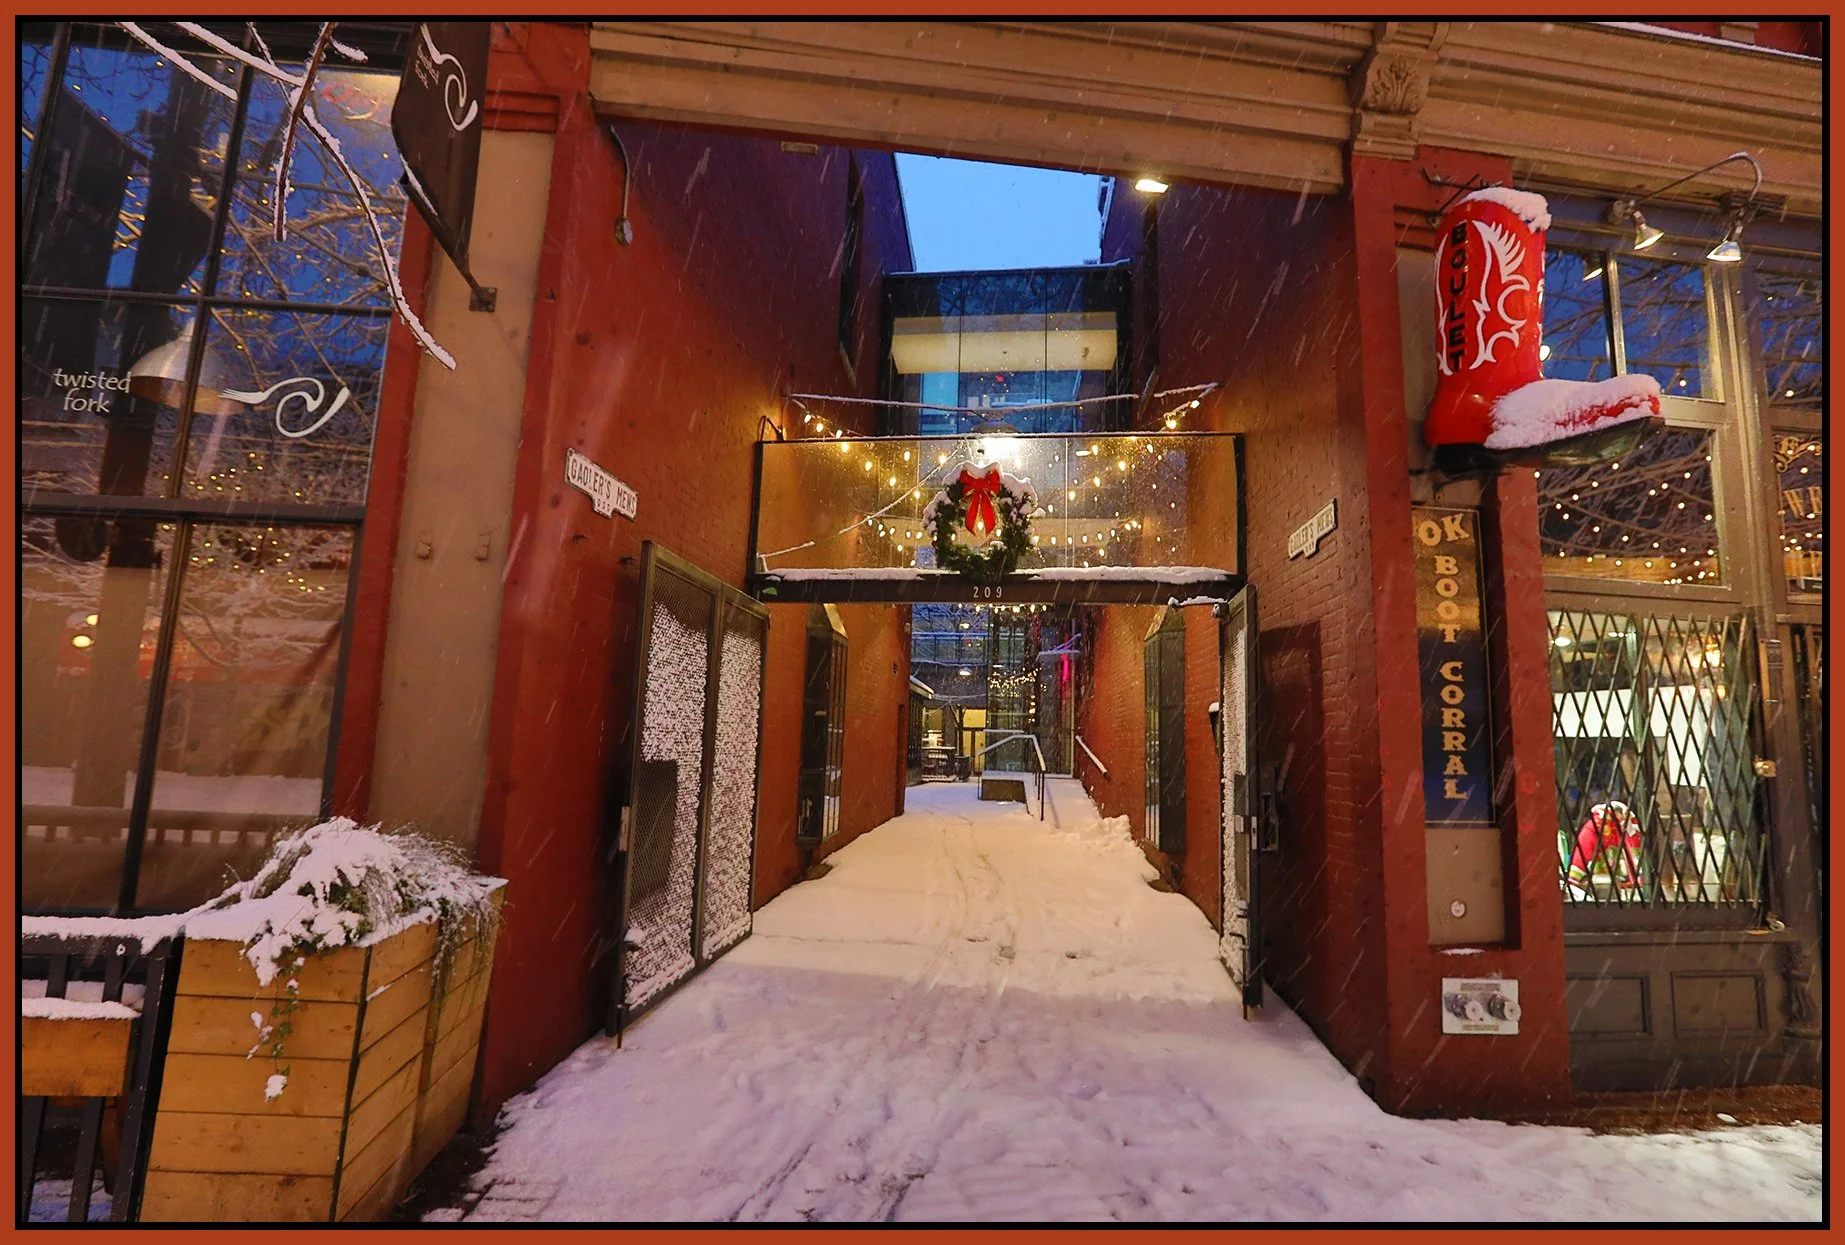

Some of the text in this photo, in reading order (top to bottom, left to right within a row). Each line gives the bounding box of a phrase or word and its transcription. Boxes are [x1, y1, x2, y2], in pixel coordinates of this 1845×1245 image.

[1448, 220, 1468, 373] BOULET
[53, 368, 132, 393] twisted
[63, 388, 110, 413] fork
[615, 486, 636, 515] MEWS
[1420, 513, 1470, 547] OK
[973, 586, 1002, 599] 209
[1434, 555, 1461, 643] BOOT
[1440, 661, 1469, 799] CORRAL
